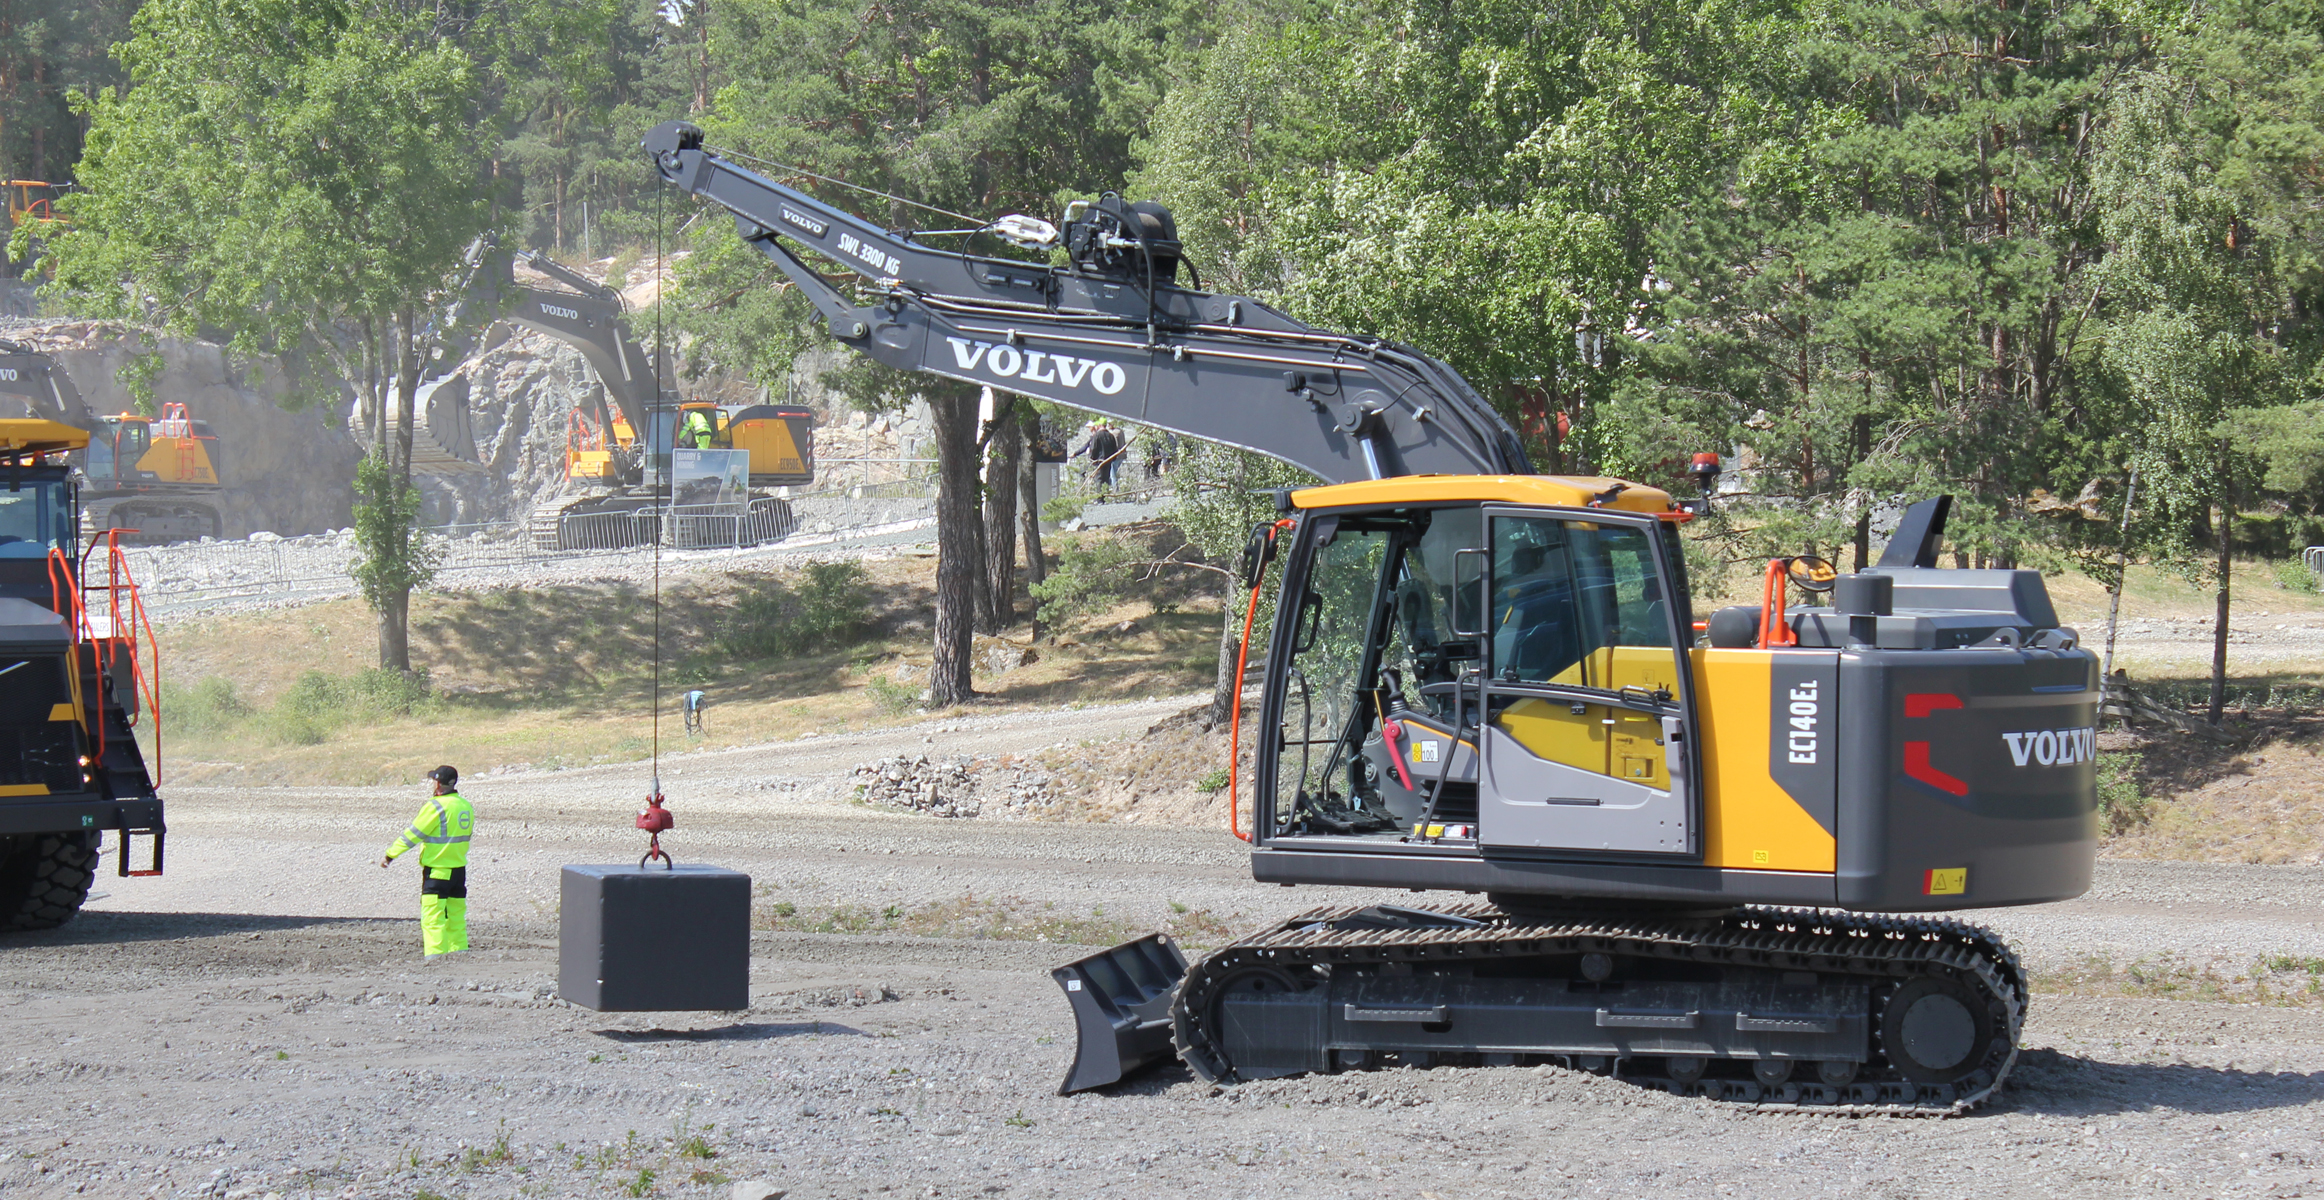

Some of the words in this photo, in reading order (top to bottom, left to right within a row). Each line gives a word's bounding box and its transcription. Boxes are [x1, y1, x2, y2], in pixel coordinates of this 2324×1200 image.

[782, 208, 822, 234] VOLVO
[837, 232, 860, 257] SWL
[859, 243, 886, 269] 3300
[884, 256, 901, 276] KG
[540, 302, 578, 320] VOLVO
[946, 336, 1126, 395] VOLVO
[676, 452, 696, 460] QUARRY
[1422, 749, 1435, 760] 100
[2002, 726, 2096, 767] VOLVO
